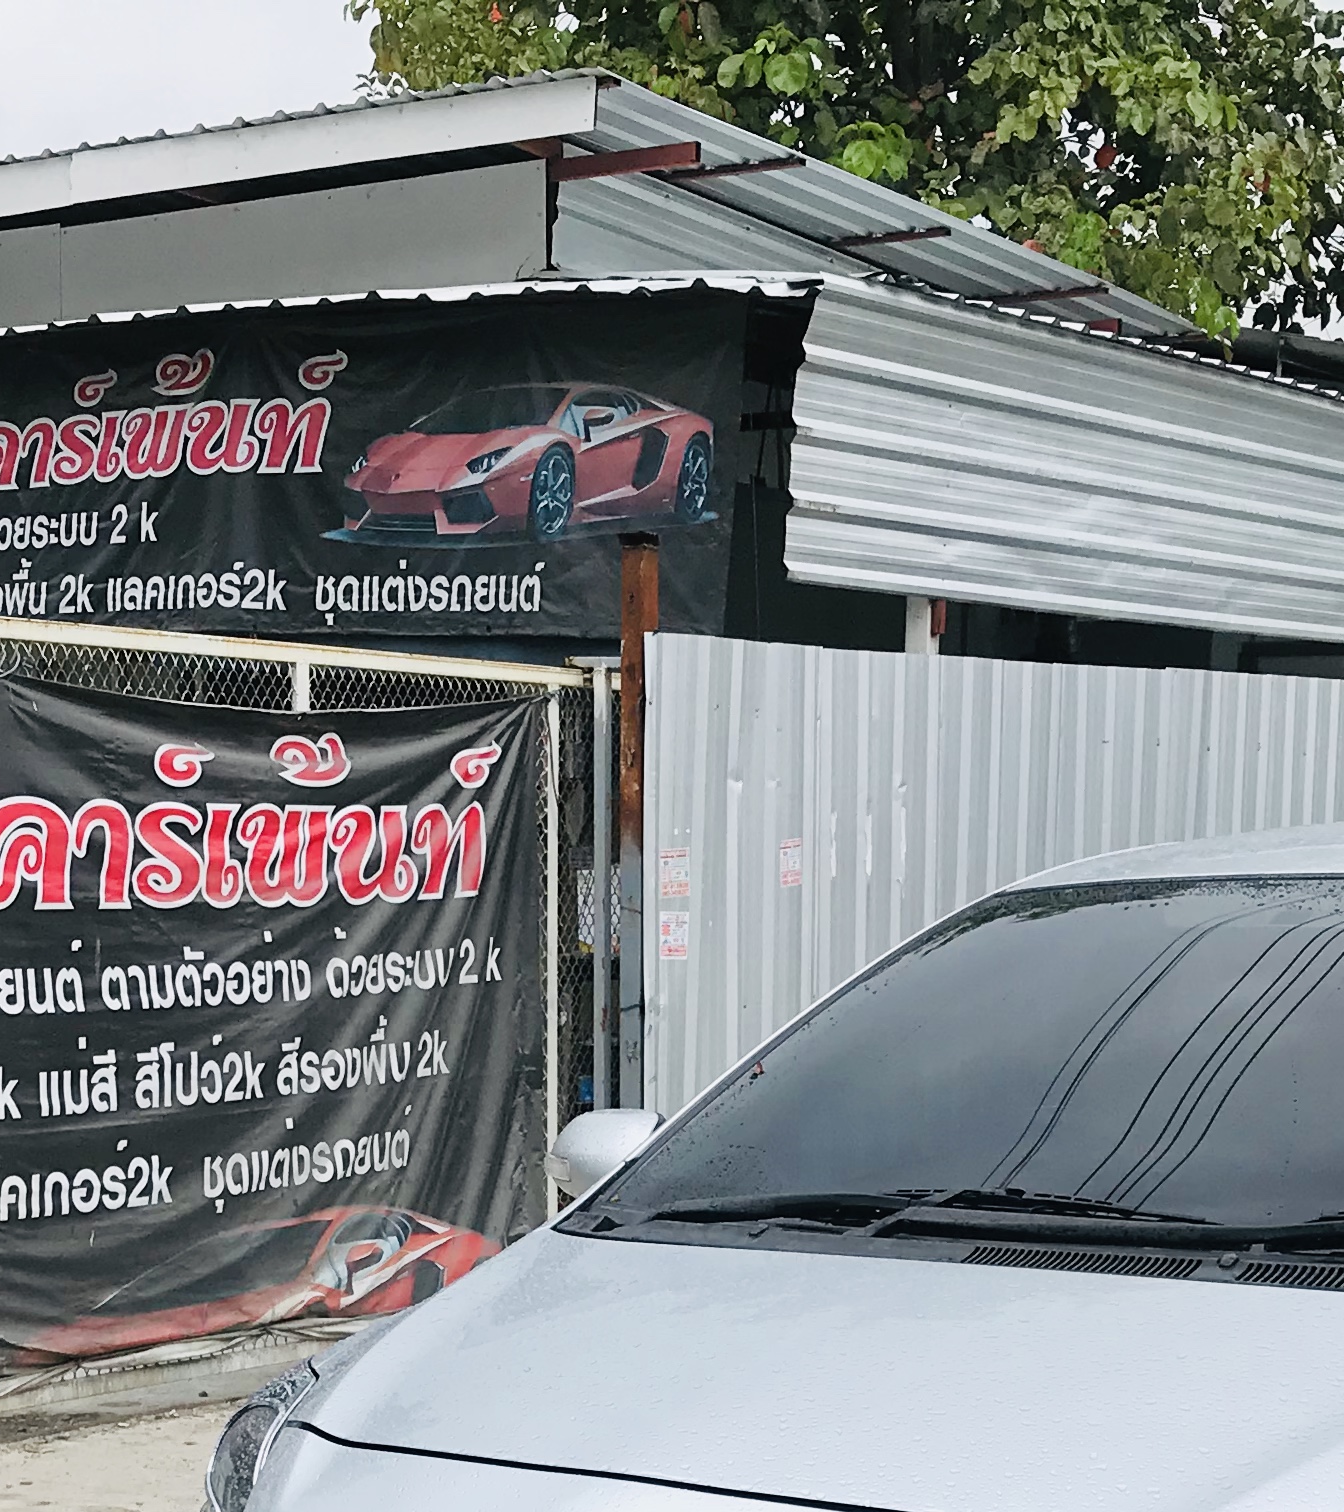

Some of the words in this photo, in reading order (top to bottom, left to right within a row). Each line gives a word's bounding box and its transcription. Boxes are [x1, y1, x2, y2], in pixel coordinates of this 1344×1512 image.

[109, 504, 128, 544] 2
[58, 573, 95, 614] 2k
[106, 561, 288, 612] แลคเกอร์2k
[314, 559, 546, 626] ชุดแต่งรถยนต์
[101, 930, 312, 1011] ตามตัวอย่าง
[326, 926, 455, 998] ด้วยระบบ
[38, 1036, 118, 1117] แม่สี
[135, 1034, 266, 1109] สีโปว์2k
[276, 1015, 411, 1096] สีรองพื้น
[416, 1030, 451, 1078] 2k
[204, 1104, 412, 1214] ชุดแต่งรถยนต์
